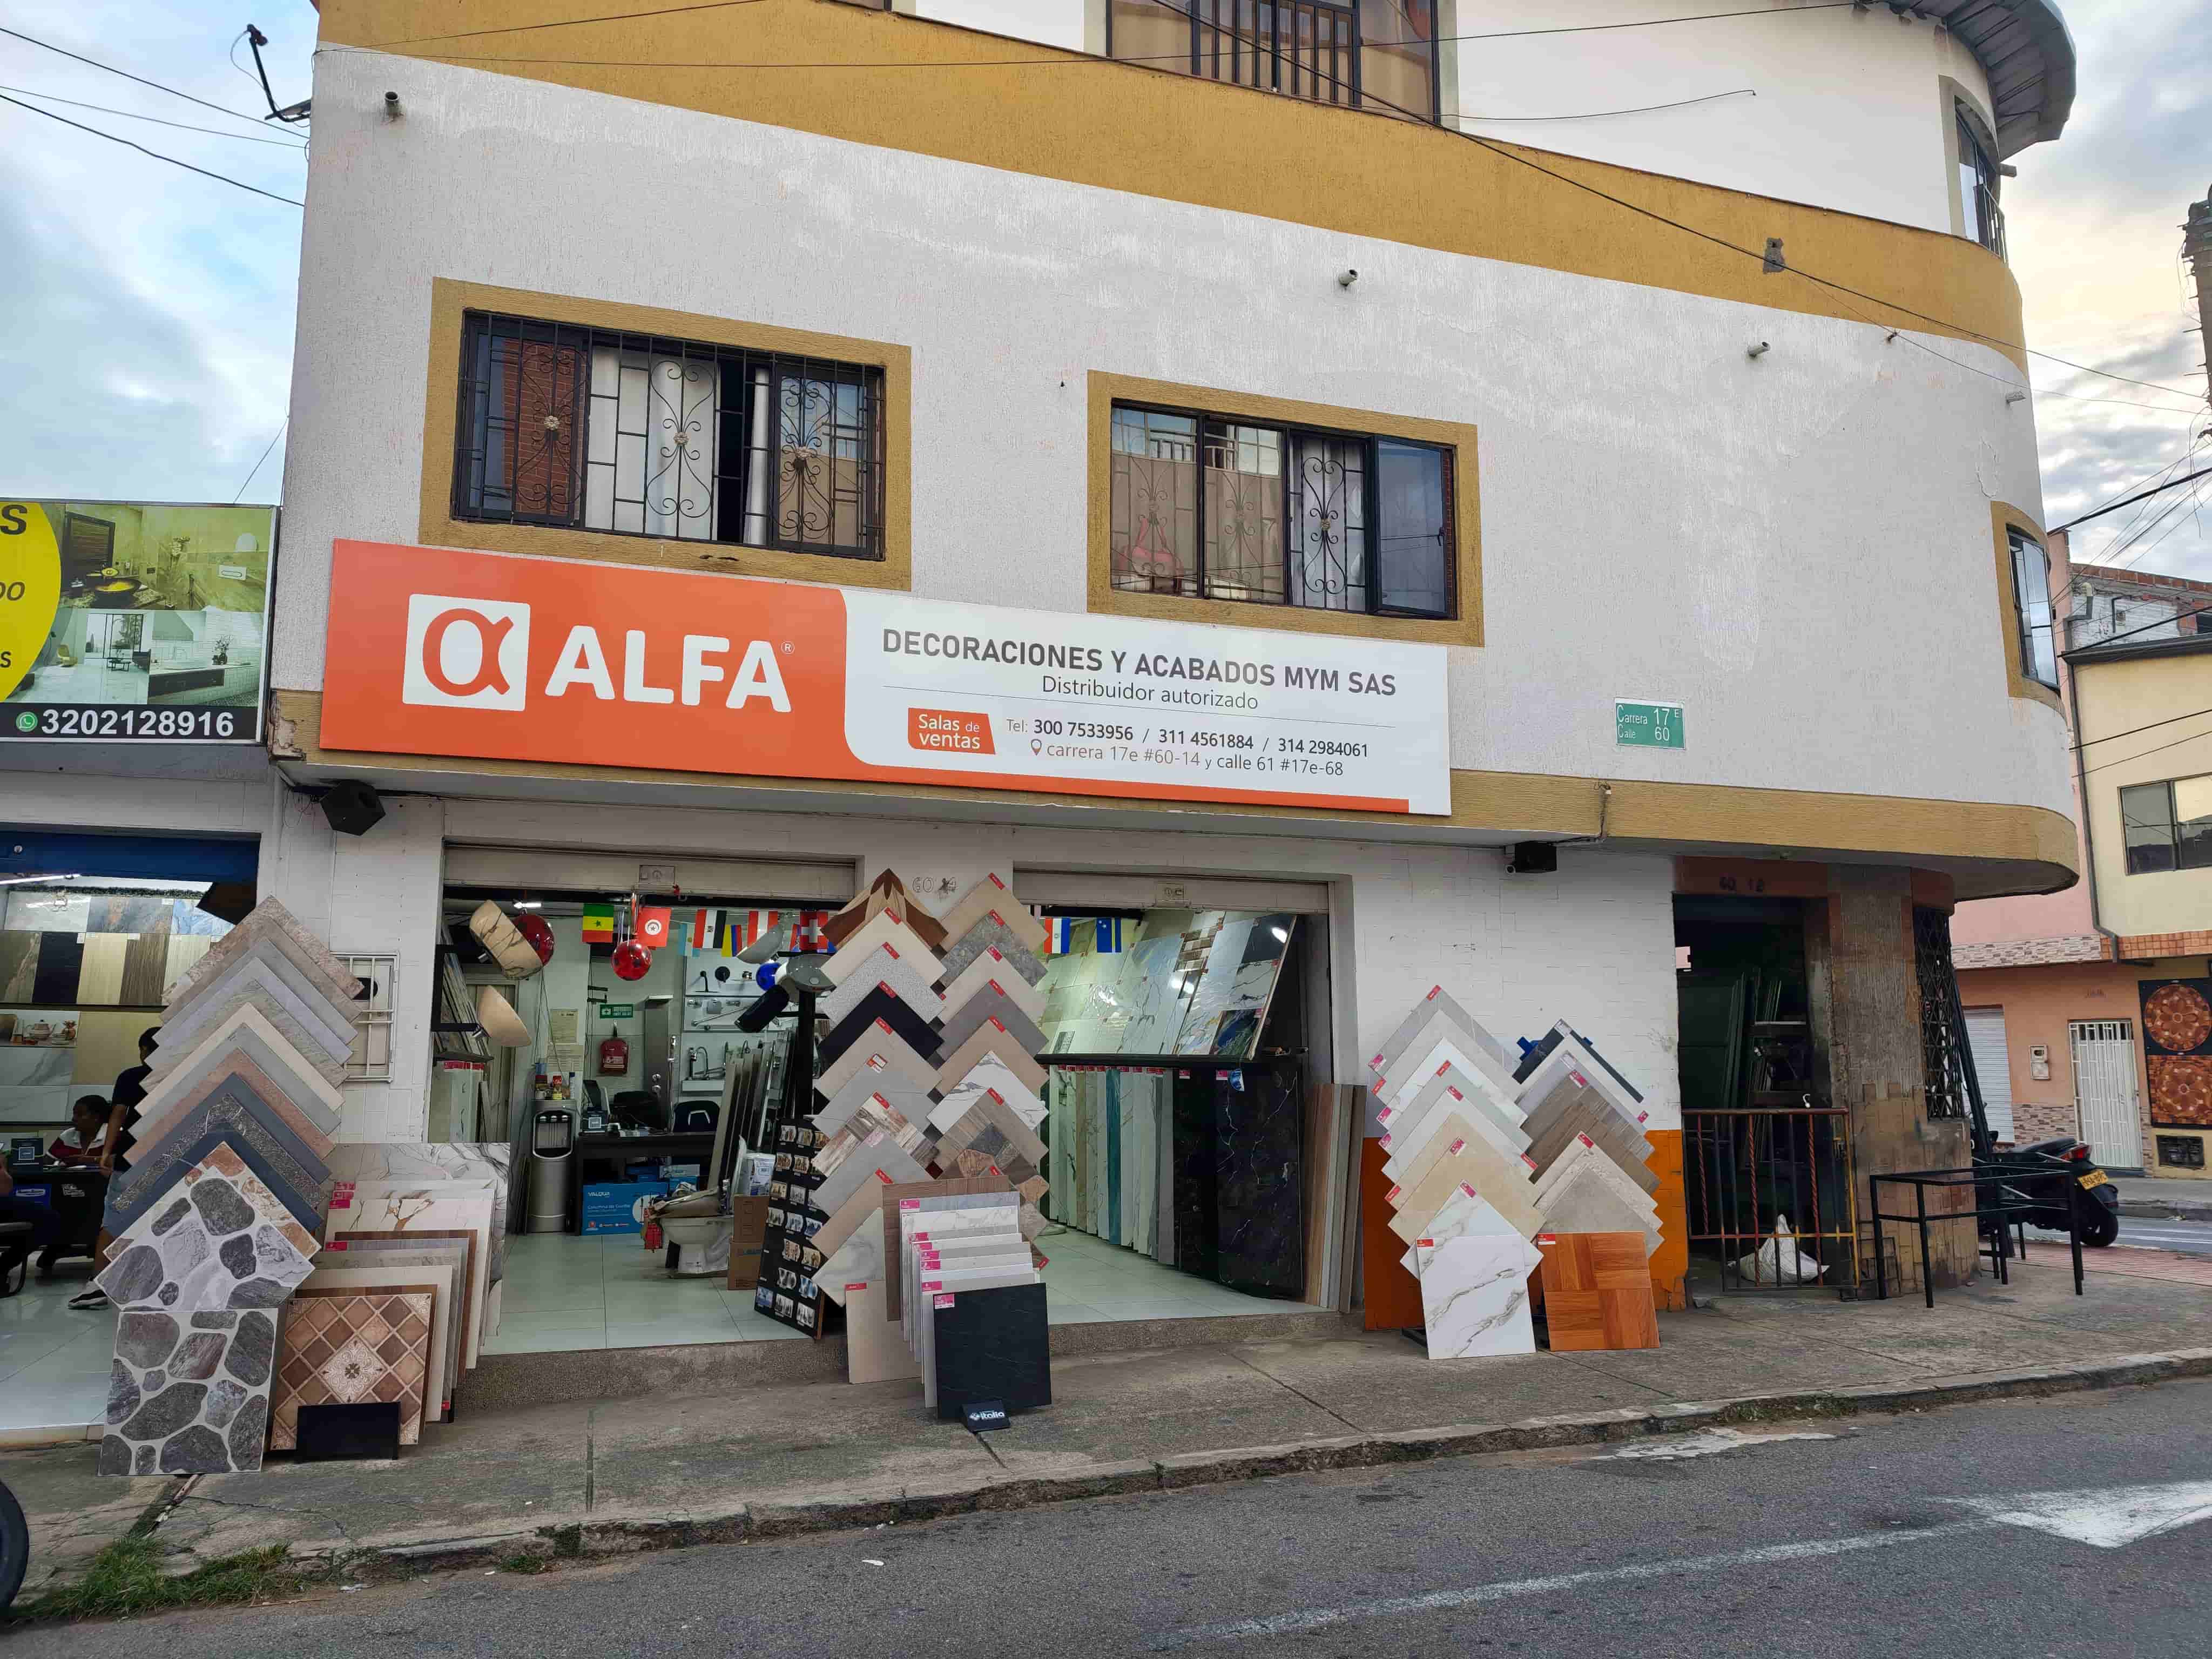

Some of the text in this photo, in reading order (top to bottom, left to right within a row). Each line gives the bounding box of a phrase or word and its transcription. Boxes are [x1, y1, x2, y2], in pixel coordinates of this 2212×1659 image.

[545, 625, 792, 713] ALFA
[883, 628, 1396, 696] DECORACIONES Y ACABADOS MYM SAS
[1042, 675, 1258, 709] Distribuidor autorizado
[41, 709, 234, 737] 3202128916
[918, 713, 980, 732] Salas de
[1616, 704, 1648, 725] Carrera
[1654, 707, 1670, 726] 17
[919, 732, 981, 750] ventas
[1006, 719, 1368, 758] Tel: 300 7533956 / 311 4561884 / 314 2984061
[1617, 724, 1670, 741] Calle 60
[1047, 744, 1344, 776] carrera 17e #60-14 y calle 61 #17e-68
